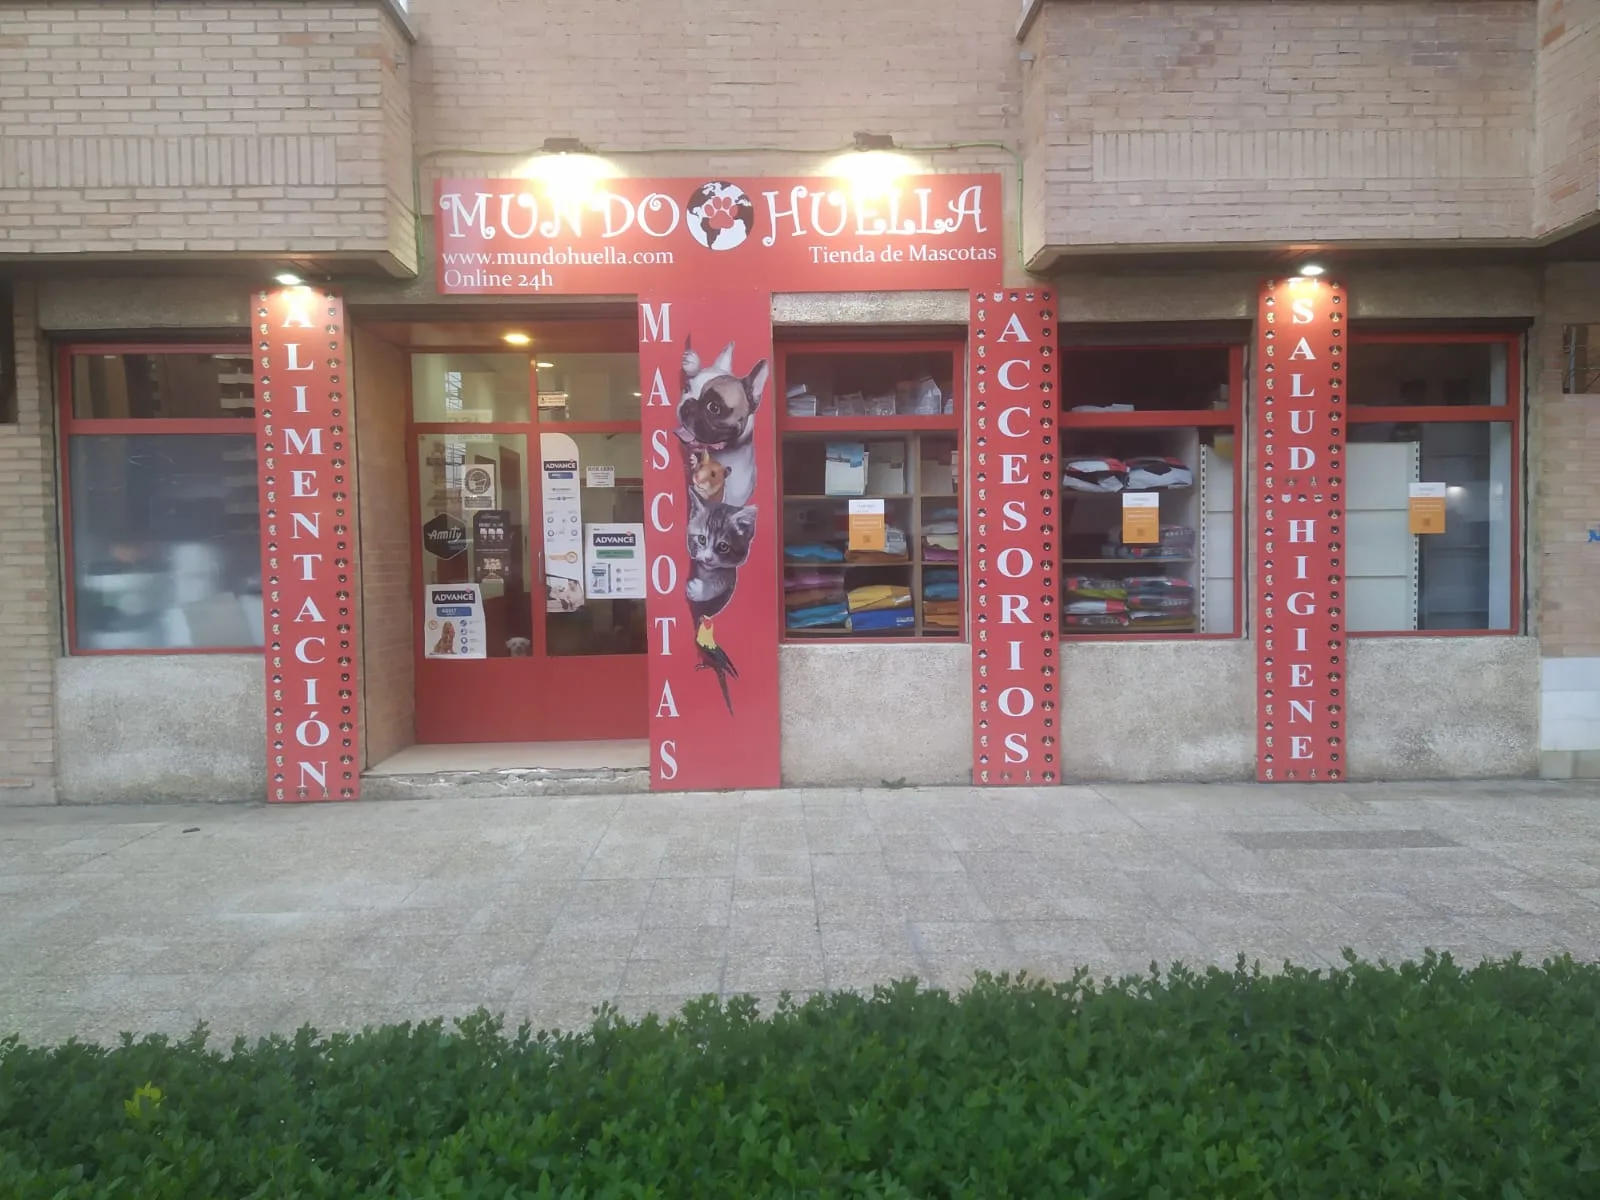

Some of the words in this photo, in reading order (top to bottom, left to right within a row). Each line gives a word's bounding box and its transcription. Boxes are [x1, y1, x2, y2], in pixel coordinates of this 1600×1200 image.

[440, 191, 680, 239] MUNDO
[762, 185, 987, 247] HUELLA
[442, 247, 674, 265] www.mundohuella.com
[444, 269, 513, 287] Online
[518, 269, 554, 291] 24h
[809, 245, 875, 263] Tienda
[880, 245, 904, 262] de
[909, 244, 997, 262] Mascotas
[1287, 299, 1318, 471] SALUD
[281, 299, 330, 789] ALIMENTACIÓN
[594, 536, 635, 544] ADVANCE
[640, 302, 680, 781] MASCOTAS
[996, 312, 1035, 764] ACCESORIOS
[434, 593, 474, 601] ADVANCE
[1286, 518, 1318, 761] HIGIENE
